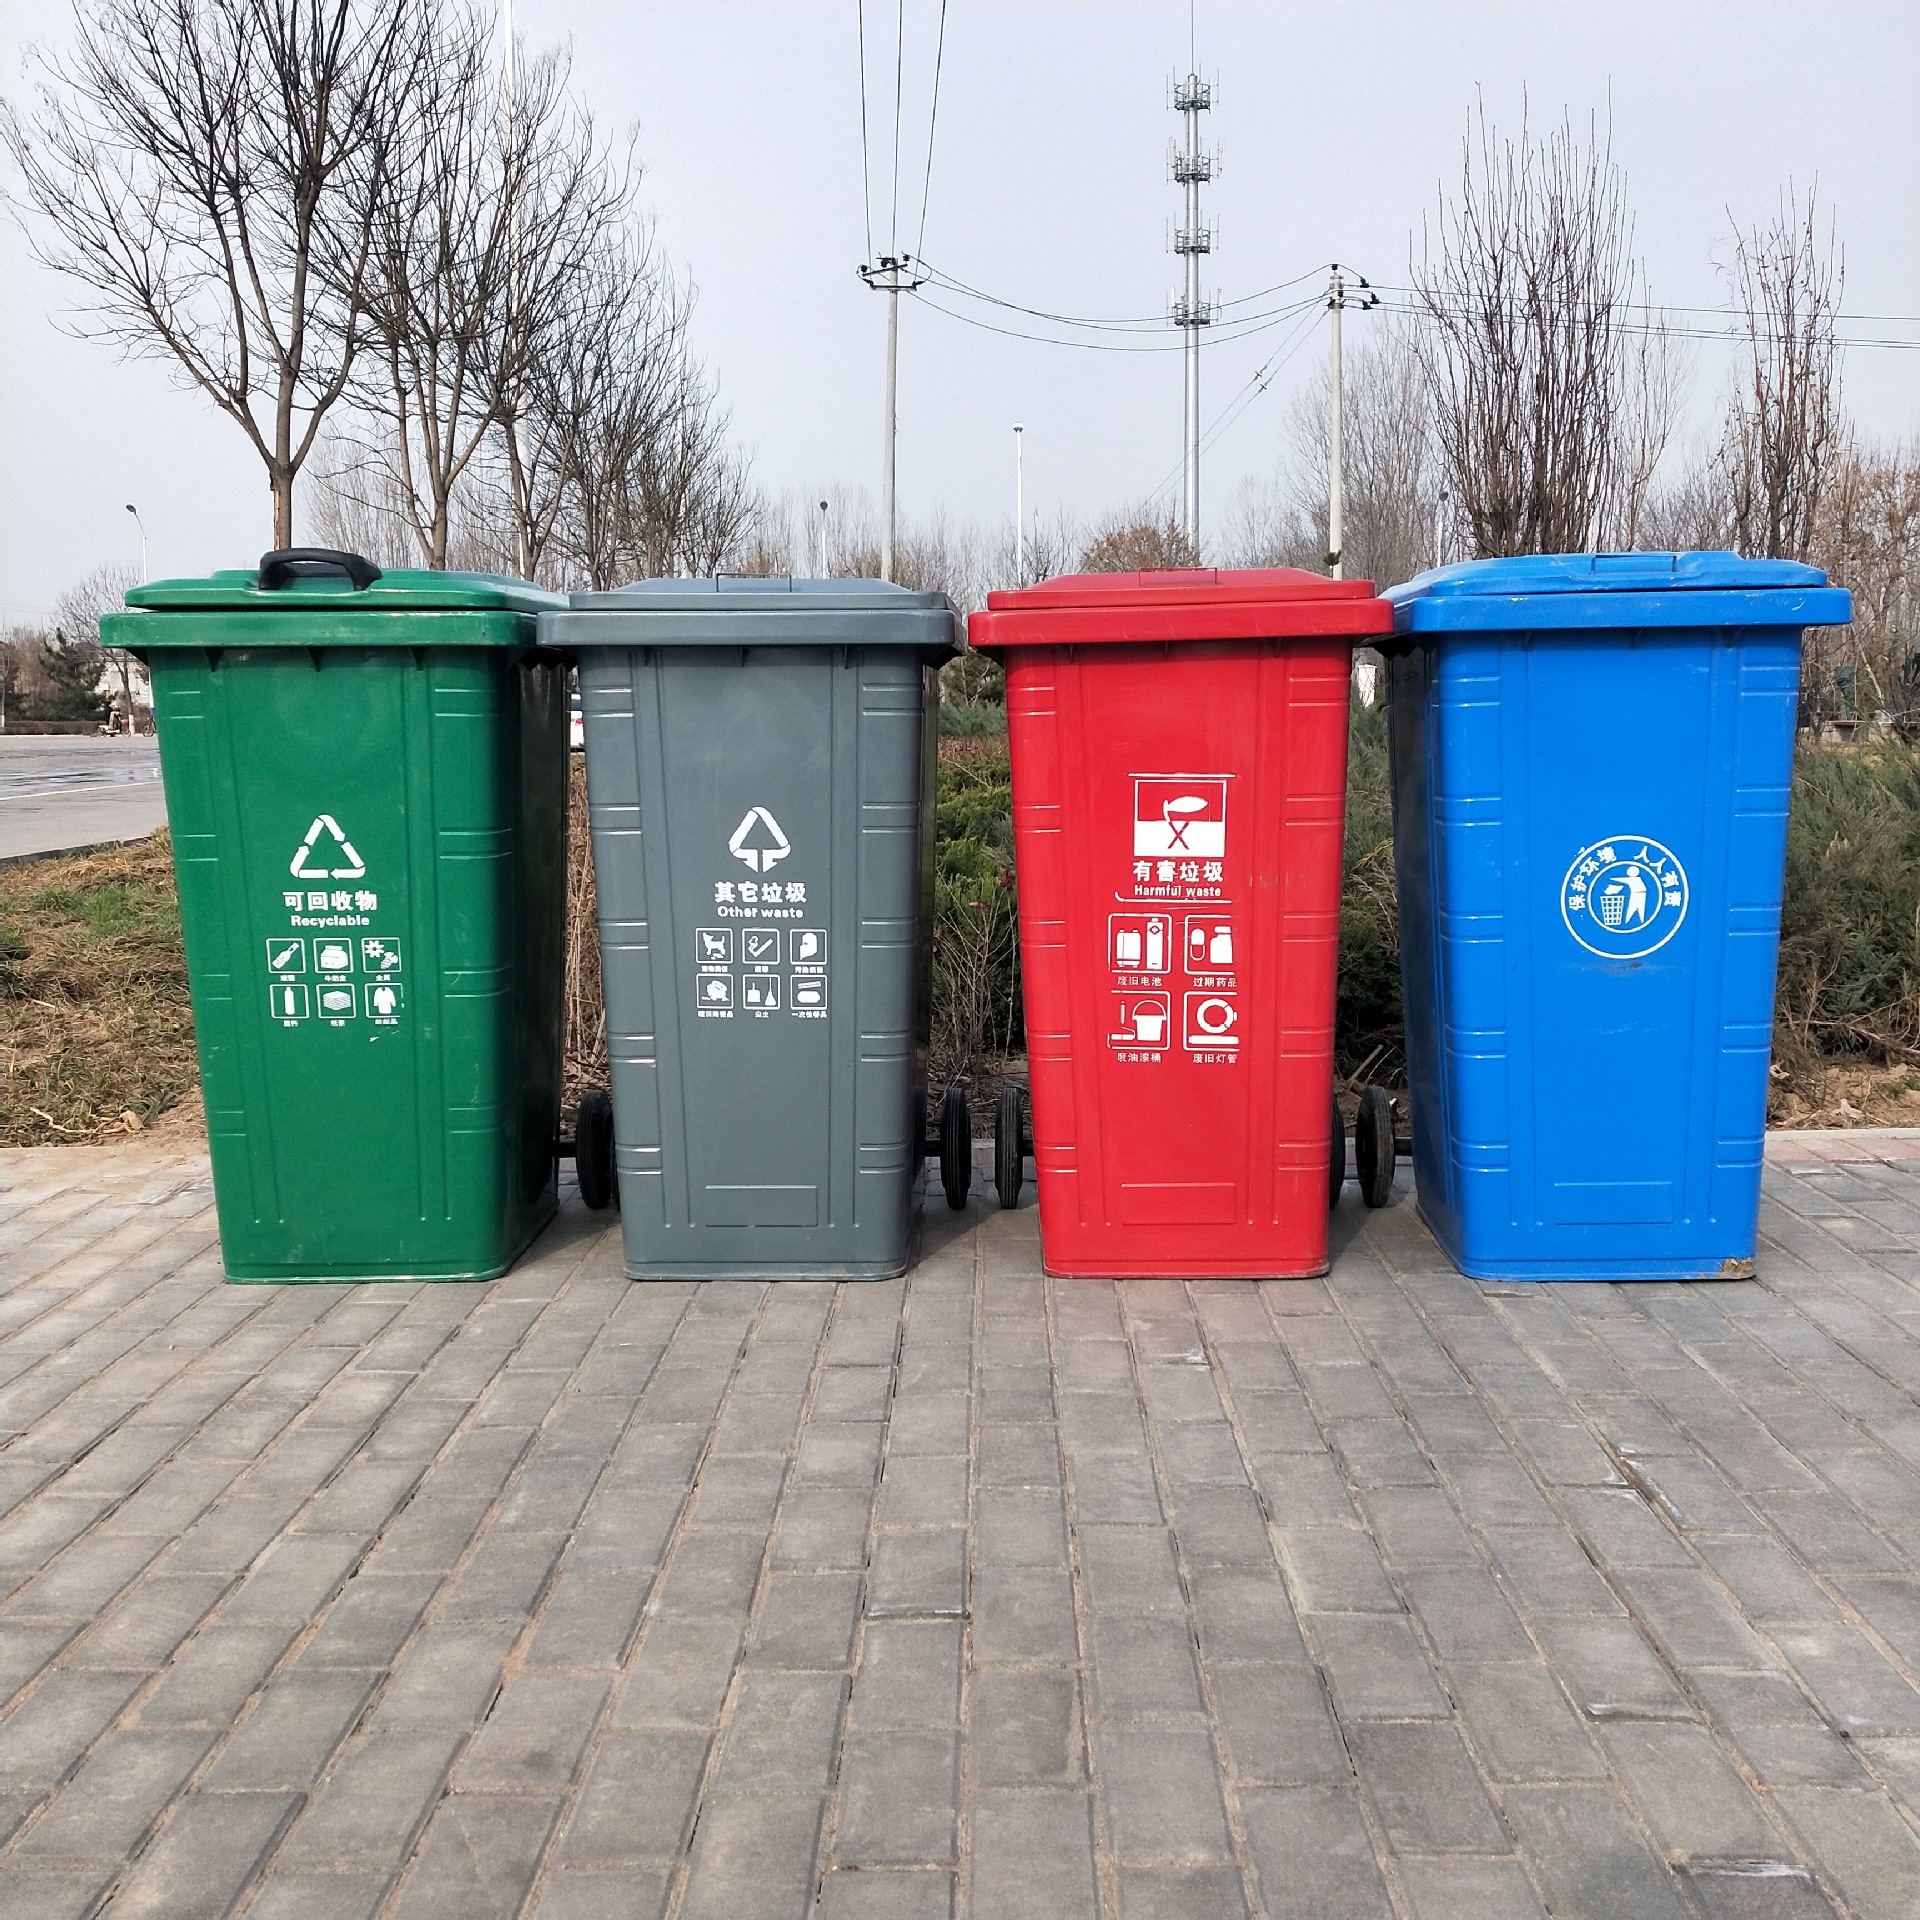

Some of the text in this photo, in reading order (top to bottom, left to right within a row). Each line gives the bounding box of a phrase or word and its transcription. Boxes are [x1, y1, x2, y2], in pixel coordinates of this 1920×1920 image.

[1133, 860, 1224, 882] 有害垃圾
[1568, 845, 1682, 911] 保护环境 人人有责
[714, 881, 807, 903] 其它垃圾
[1134, 884, 1221, 897] Harmful waste
[282, 890, 377, 911] 可回收物
[717, 906, 804, 918] Other waste
[290, 915, 370, 928] Recyclable
[1117, 976, 1162, 987] 废旧电池
[1193, 977, 1238, 987] 过期药品
[1193, 1053, 1238, 1064] 废旧灯管
